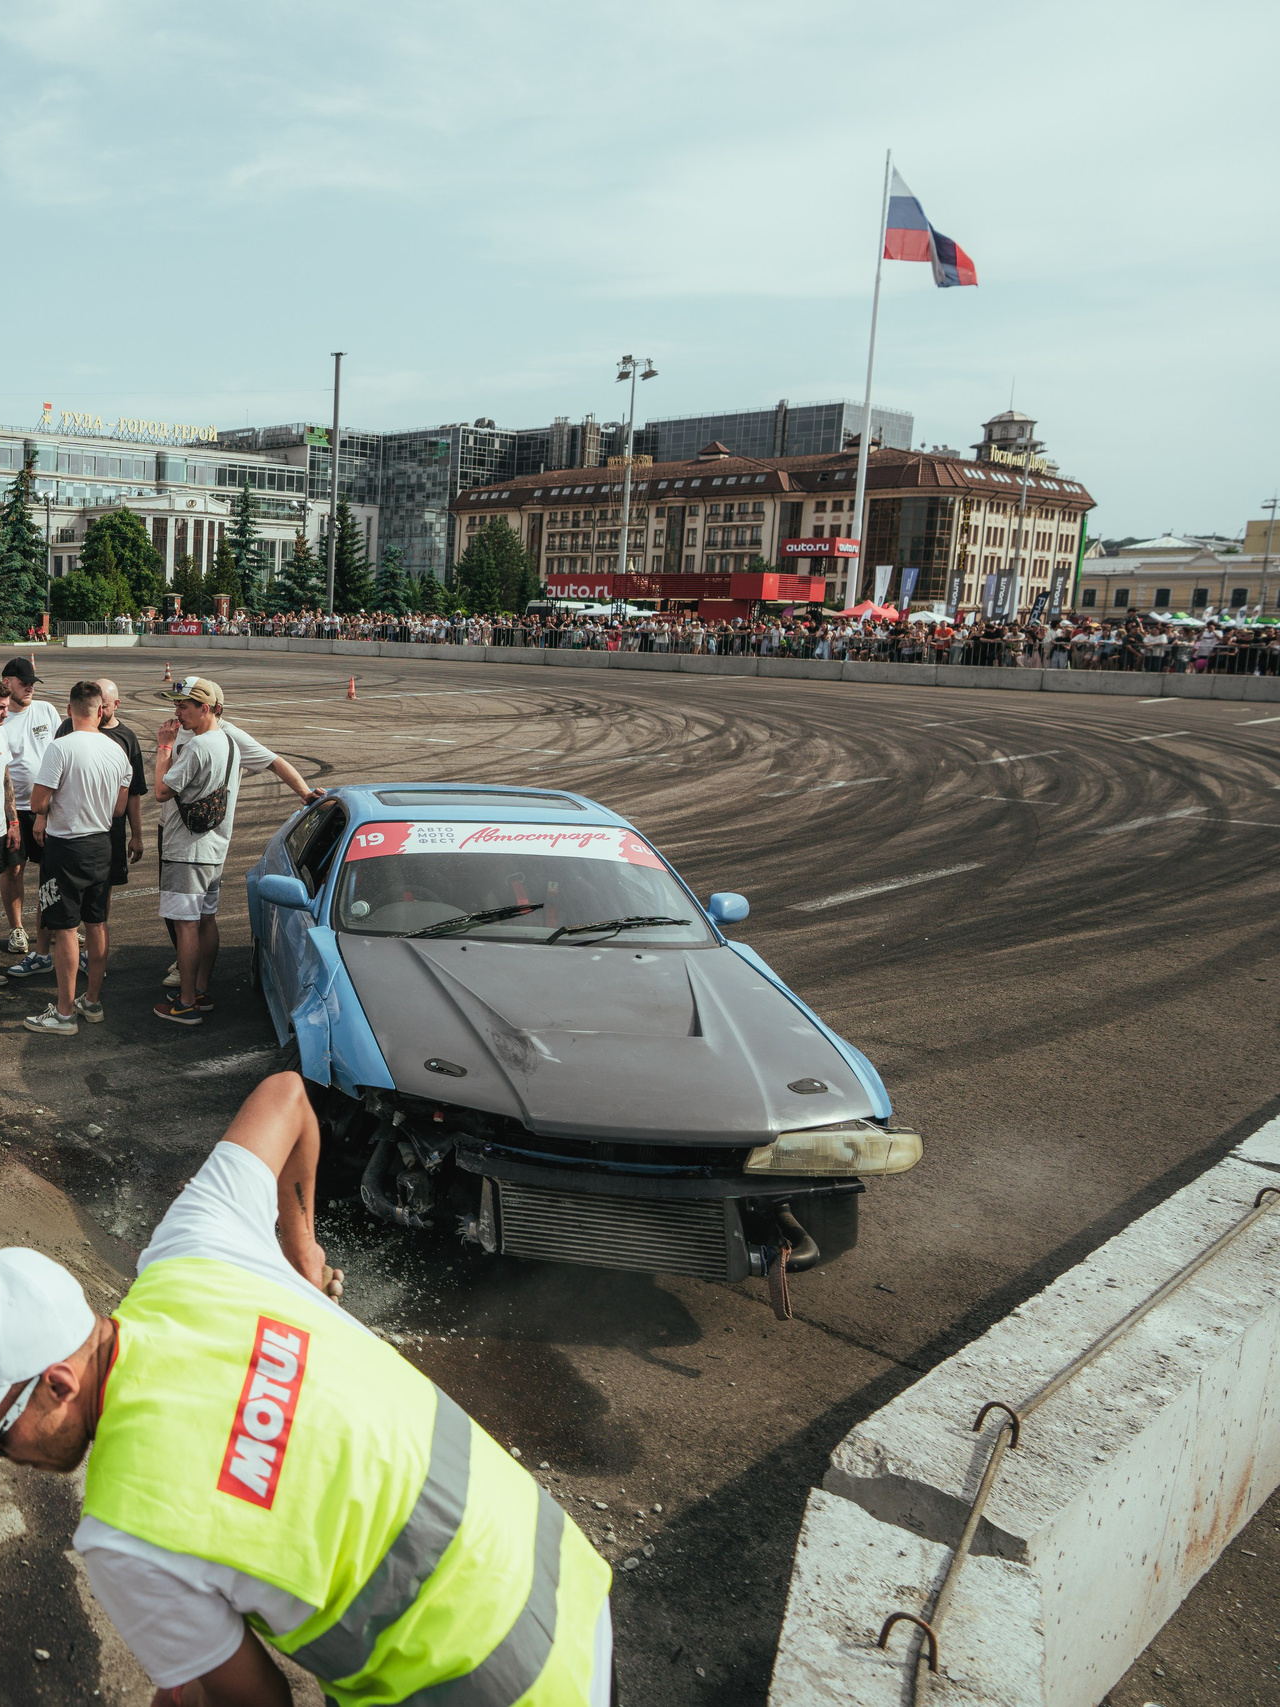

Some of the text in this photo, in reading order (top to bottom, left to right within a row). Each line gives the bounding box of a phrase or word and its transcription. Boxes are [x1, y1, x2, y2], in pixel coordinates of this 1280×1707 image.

[60, 411, 103, 430] ТУЛА
[119, 417, 219, 443] ГОРОД-ГЕРОЙ
[1028, 451, 1048, 474] Двор
[786, 542, 829, 552] auto.ru
[838, 543, 859, 553] auto.ru
[546, 583, 613, 598] auto.ru
[1053, 576, 1064, 606] EVOLUTE
[171, 625, 197, 633] LAVR
[355, 832, 385, 848] 19
[458, 826, 611, 850] Автострада
[228, 1328, 301, 1499] MOTUL
